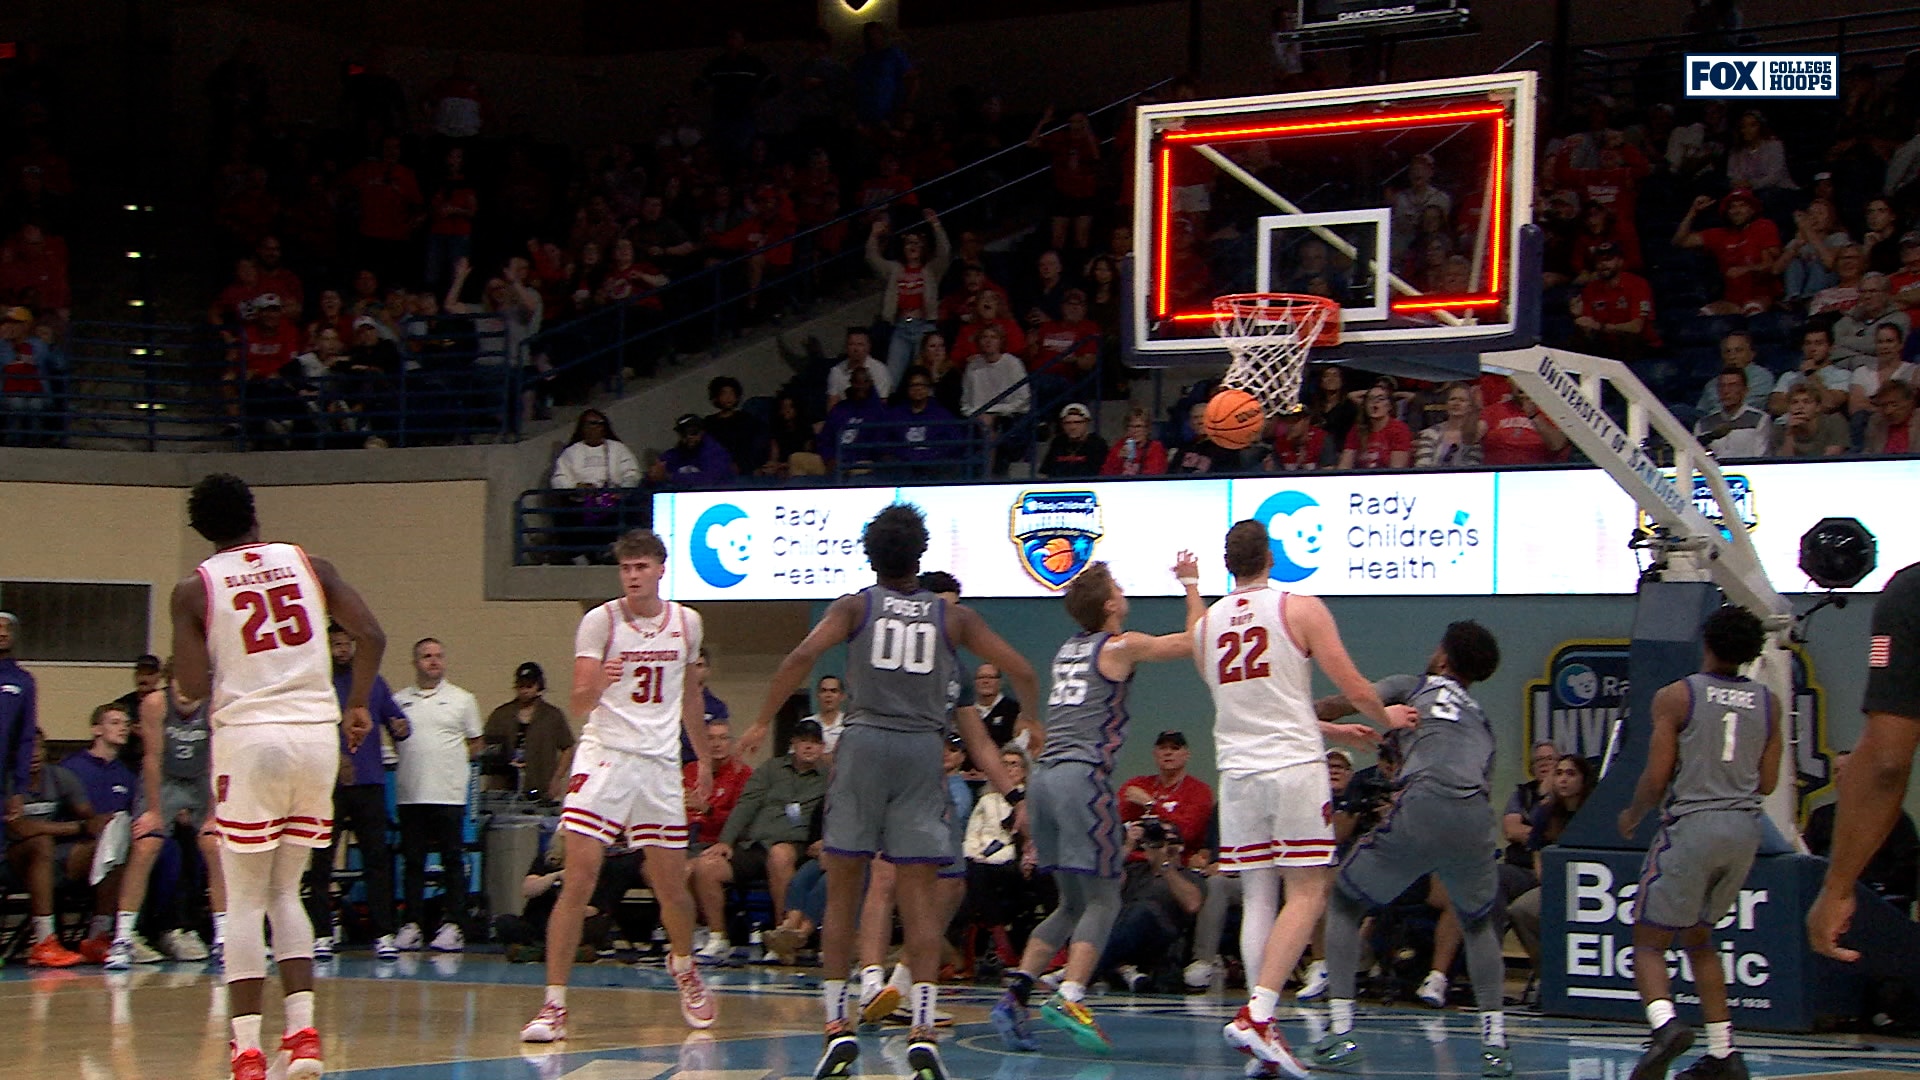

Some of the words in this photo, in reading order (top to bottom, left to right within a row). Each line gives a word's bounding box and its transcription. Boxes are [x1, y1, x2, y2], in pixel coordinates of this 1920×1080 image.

[1538, 356, 1611, 438] UNIVERSITY
[1611, 433, 1626, 454] OF
[775, 504, 831, 532] Rady
[1349, 491, 1417, 521] Rady
[224, 566, 297, 588] BLACKWELL
[1349, 555, 1436, 579] Health
[232, 584, 313, 655] 25
[882, 596, 933, 618] POSEY
[870, 617, 937, 675] 00
[1216, 625, 1271, 685] 22
[631, 665, 664, 704] 31
[1706, 685, 1757, 710] PIERRE
[1721, 711, 1739, 761] 1
[1566, 860, 1769, 930] Bar
